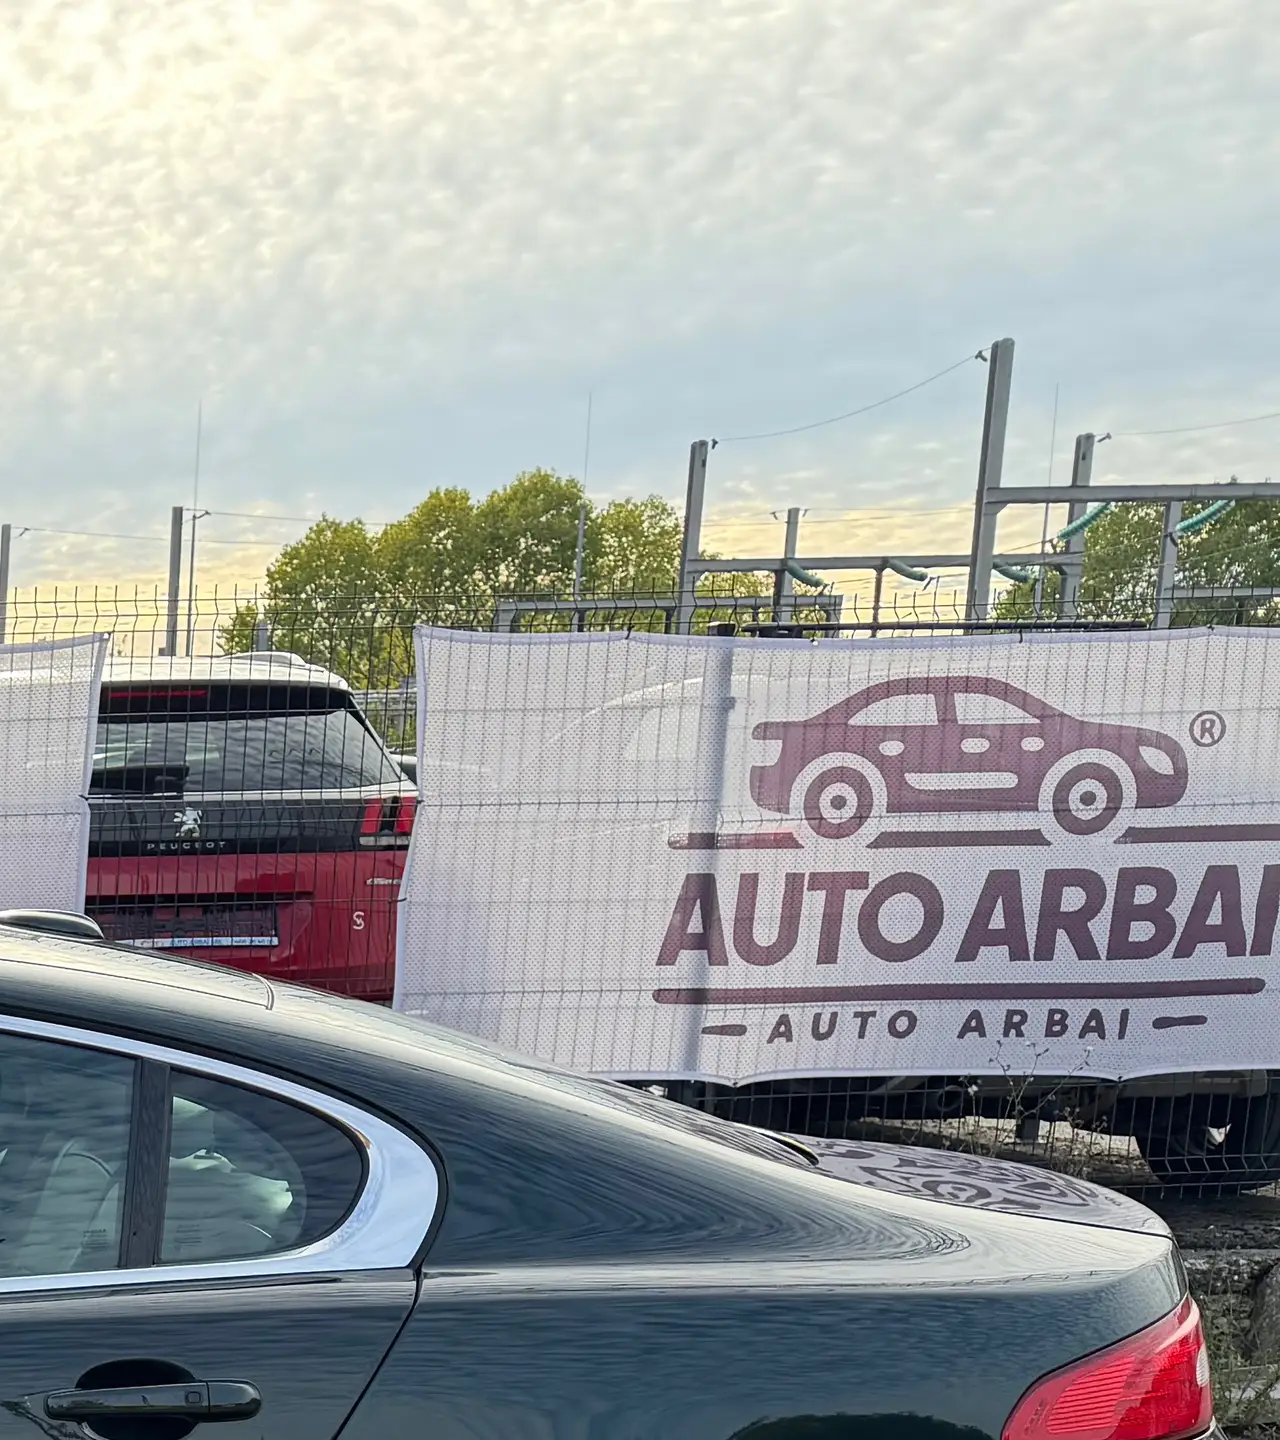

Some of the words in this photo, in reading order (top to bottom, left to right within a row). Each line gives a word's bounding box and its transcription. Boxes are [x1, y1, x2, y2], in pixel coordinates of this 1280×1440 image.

[655, 870, 944, 968] AUTO
[954, 864, 1280, 962] ARBAI
[766, 1010, 919, 1045] AUTO
[956, 1008, 1131, 1041] ARBAI
